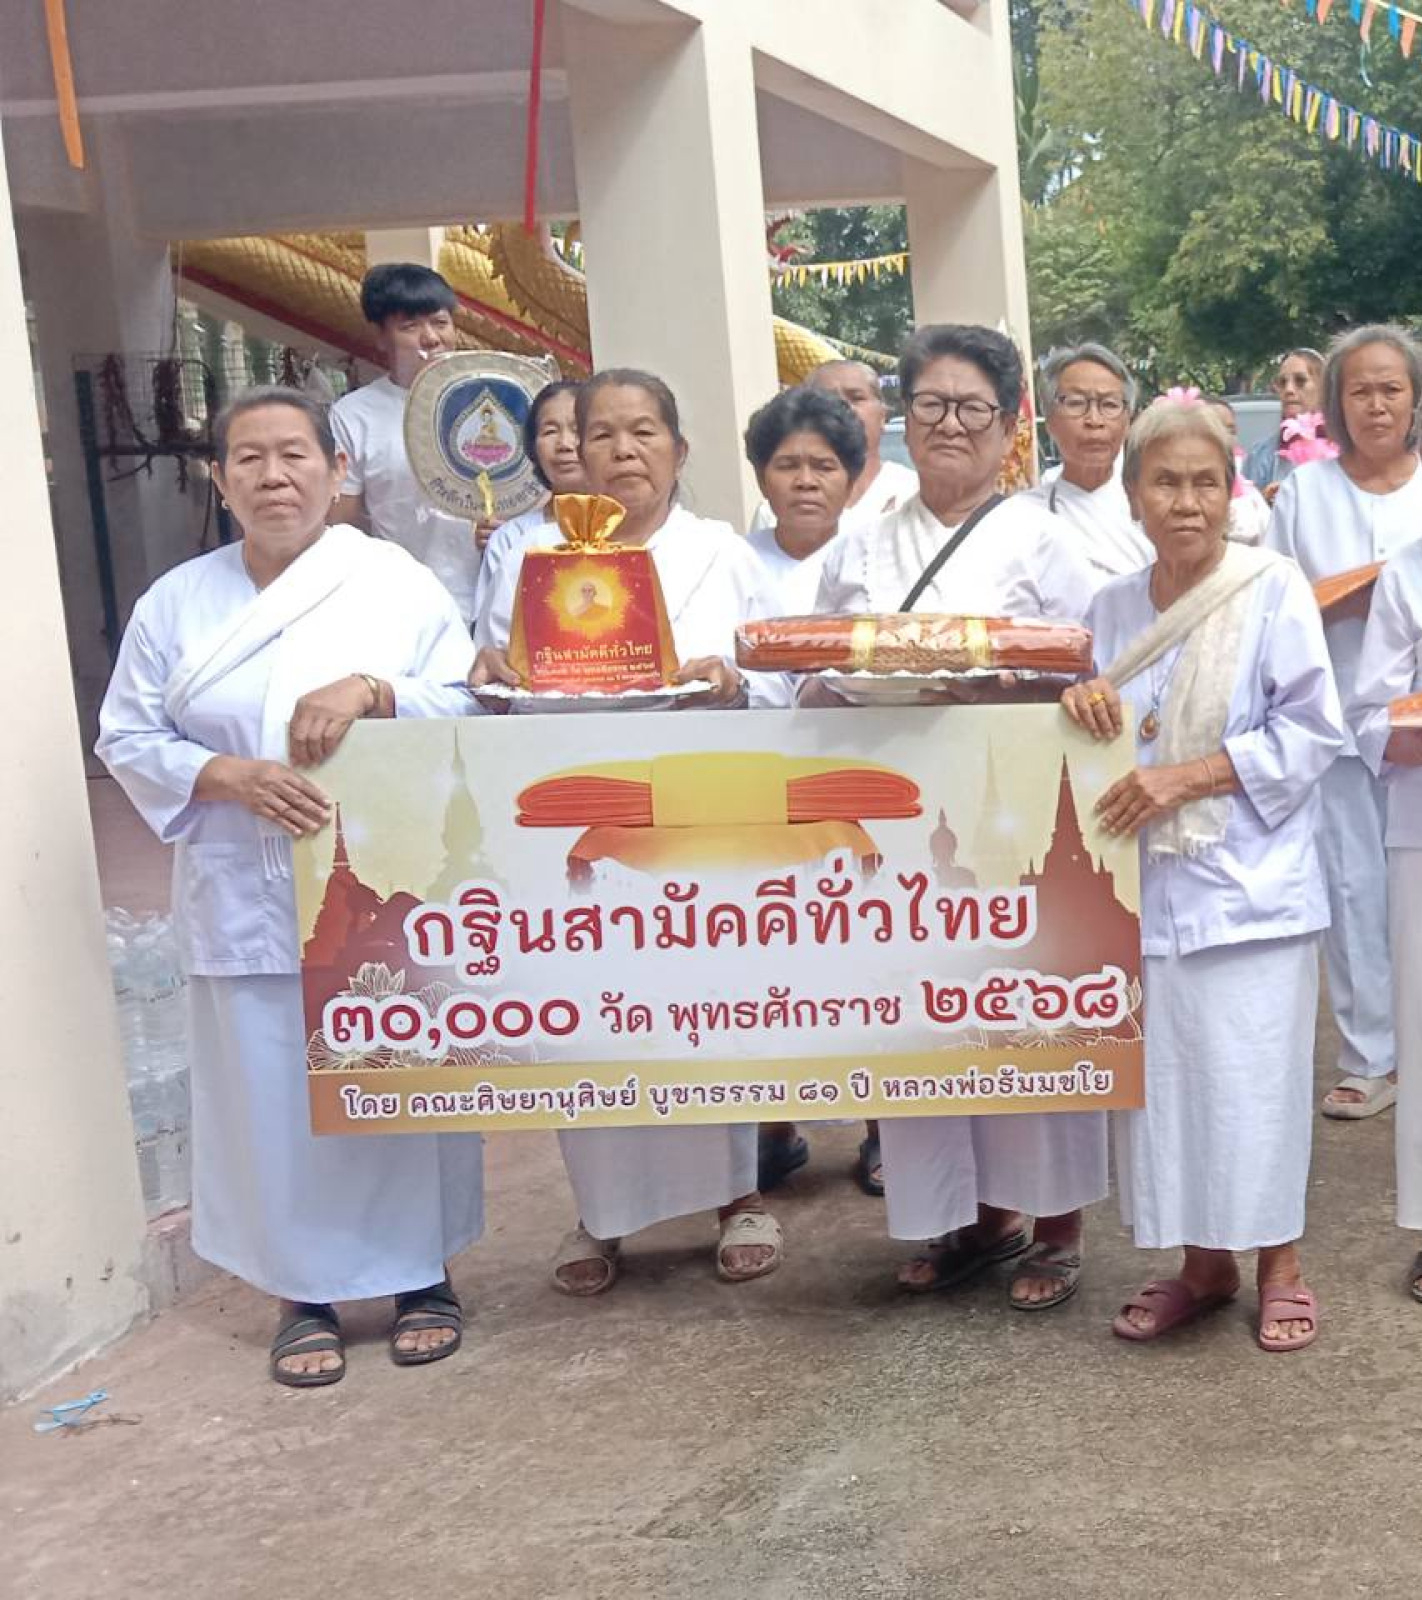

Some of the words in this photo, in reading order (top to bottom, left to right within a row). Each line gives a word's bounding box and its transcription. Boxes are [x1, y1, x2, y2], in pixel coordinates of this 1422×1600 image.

[412, 857, 1029, 976] กฐินสามัคคีทั่วไทย
[331, 998, 581, 1048] ๓๐,๐๐๐
[599, 991, 653, 1034] วัด
[668, 985, 901, 1047] พุทธศักราช
[920, 974, 1120, 1024] ๒๕๖๘
[344, 1088, 398, 1116] โดย
[411, 1077, 637, 1117] คณะศิษยานุศิษย์
[650, 1083, 785, 1116] บูชาธรรม
[799, 1081, 839, 1102] ๘๑
[850, 1072, 870, 1098] ปี
[882, 1064, 1110, 1098] หลวงพ่อธัมมชโย
